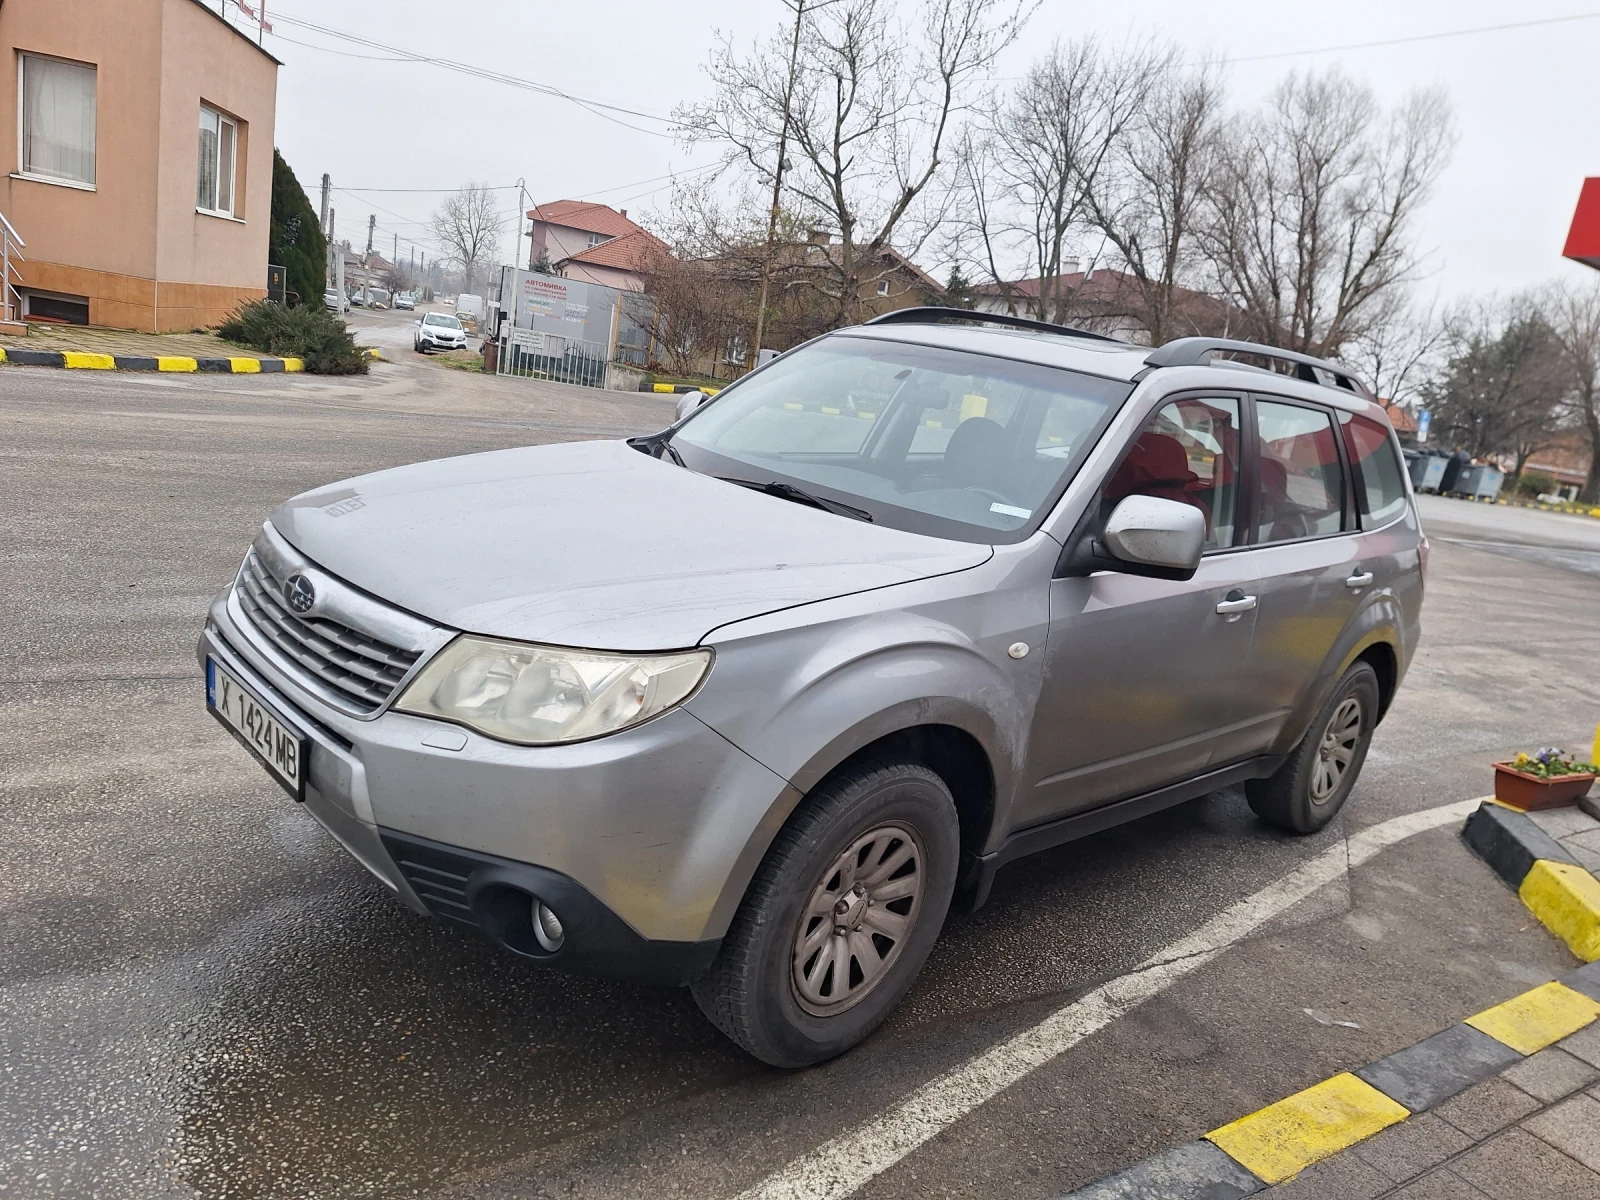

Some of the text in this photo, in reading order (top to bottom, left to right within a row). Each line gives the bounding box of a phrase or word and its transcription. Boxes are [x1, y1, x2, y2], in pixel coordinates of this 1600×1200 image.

[525, 279, 567, 291] АВТОМИВКА
[221, 675, 230, 716] X
[238, 693, 273, 757] 1424
